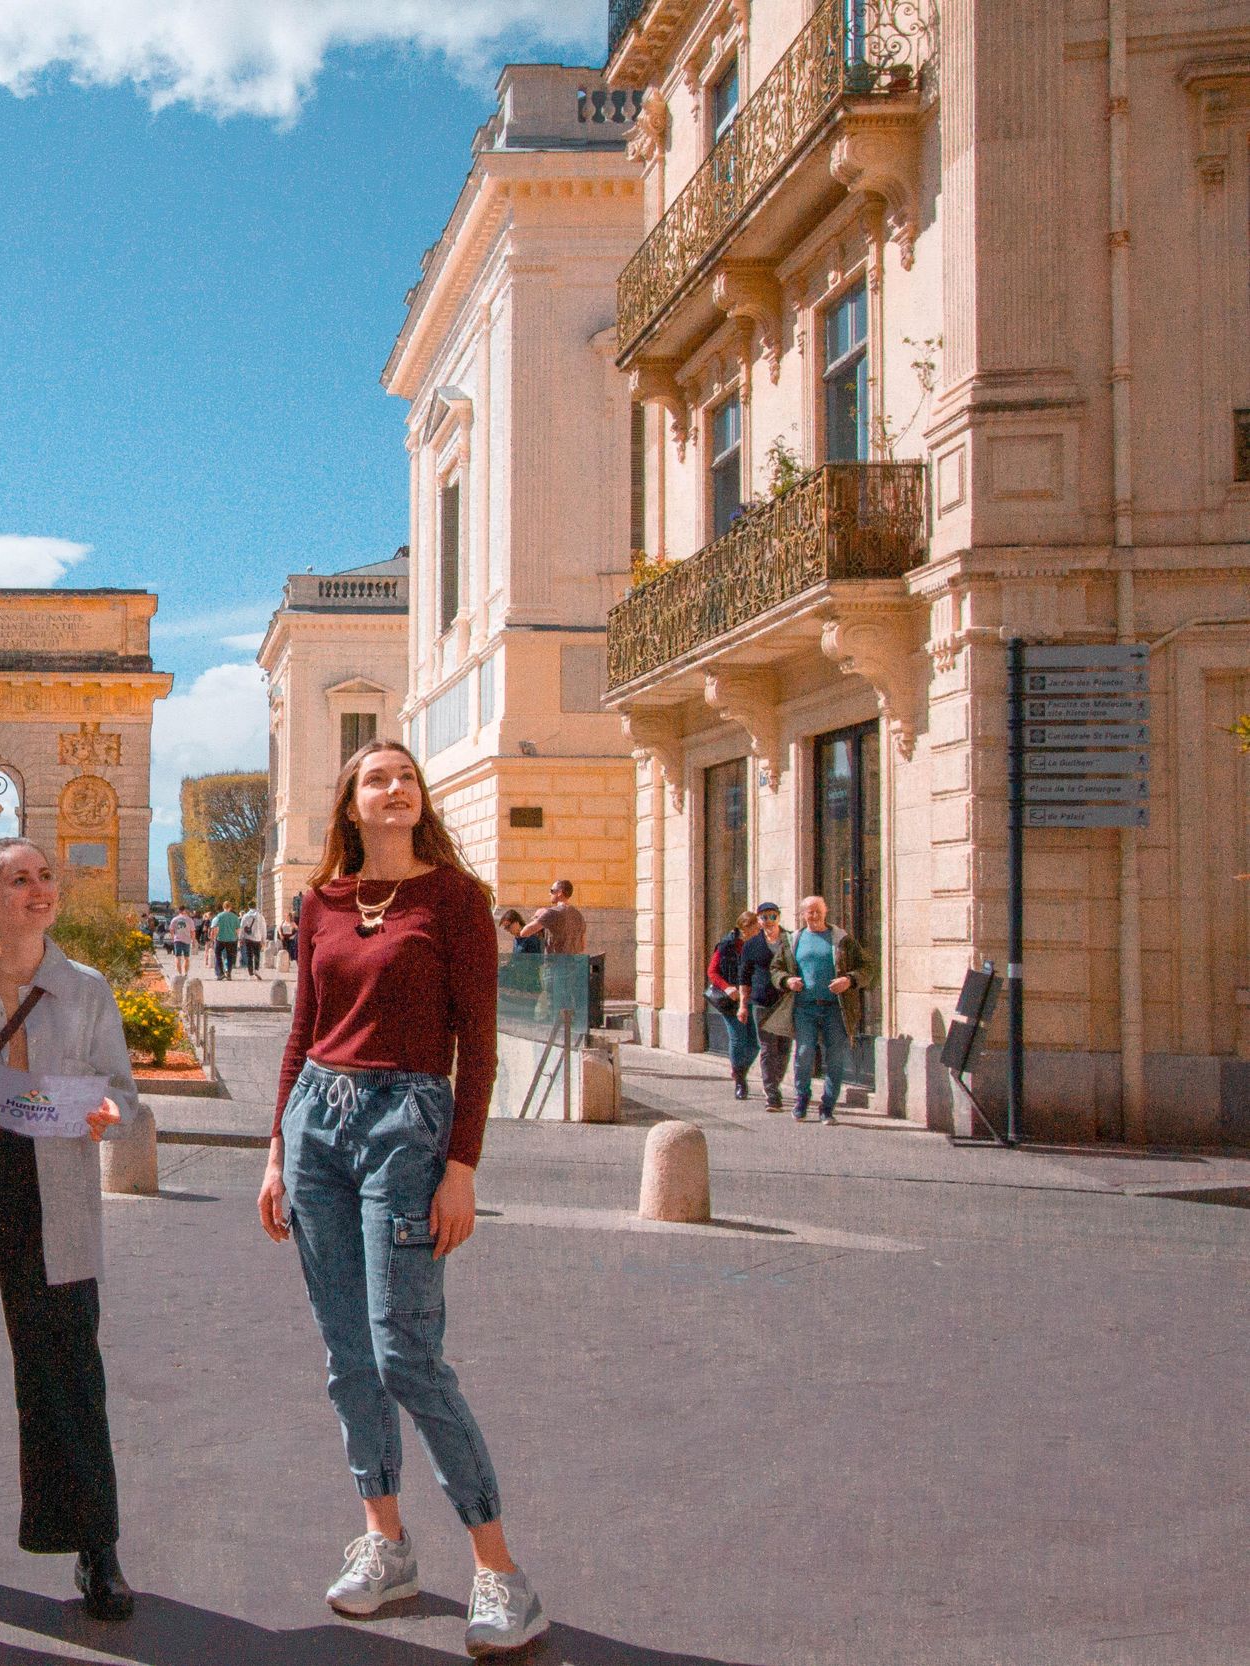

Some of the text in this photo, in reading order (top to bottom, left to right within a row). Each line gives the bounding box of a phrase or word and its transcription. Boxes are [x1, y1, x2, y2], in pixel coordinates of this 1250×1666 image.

[1048, 679, 1124, 687] Jardin des Plantes
[1080, 700, 1091, 708] de
[1065, 709, 1107, 718] historique
[1030, 785, 1052, 793] Place
[1054, 785, 1065, 793] de
[1067, 785, 1075, 793] la
[5, 1098, 56, 1113] Hunting
